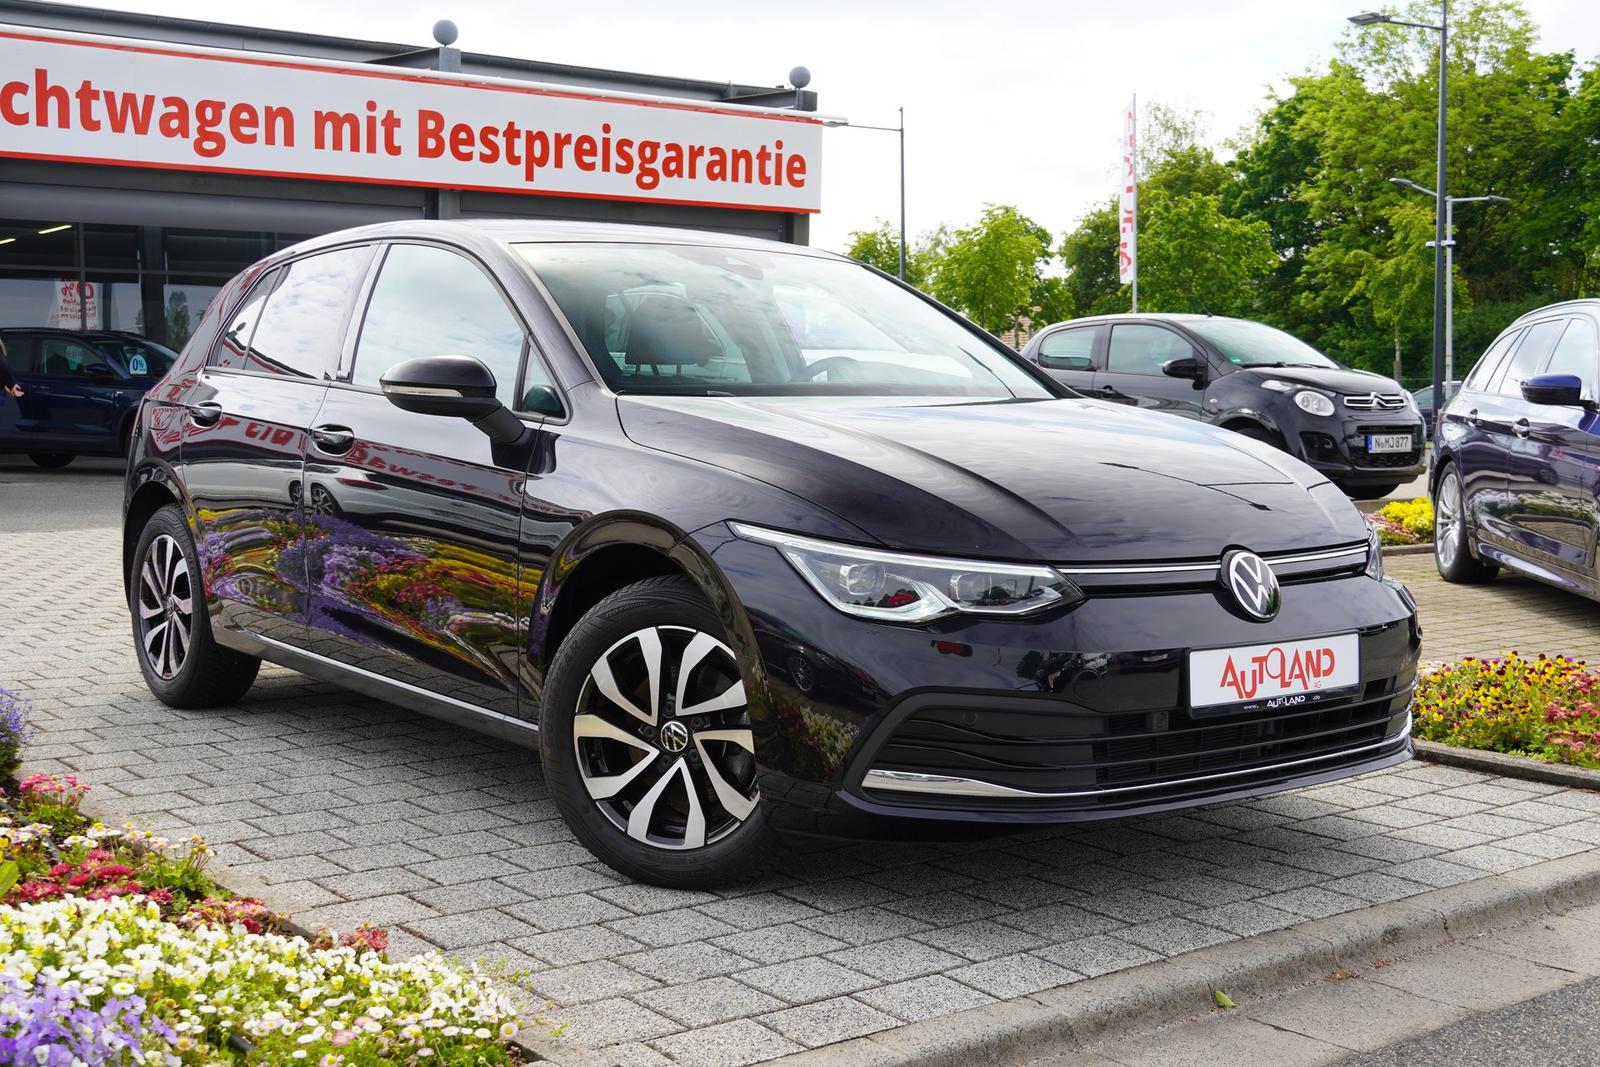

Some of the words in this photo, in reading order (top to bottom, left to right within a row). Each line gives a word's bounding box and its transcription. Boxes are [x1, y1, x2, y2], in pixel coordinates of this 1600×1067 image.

[0, 68, 295, 158] chtwagen
[314, 100, 402, 156] mit
[418, 109, 807, 191] Bestpreisgarantie
[1219, 647, 1336, 699] AUTOLAND
